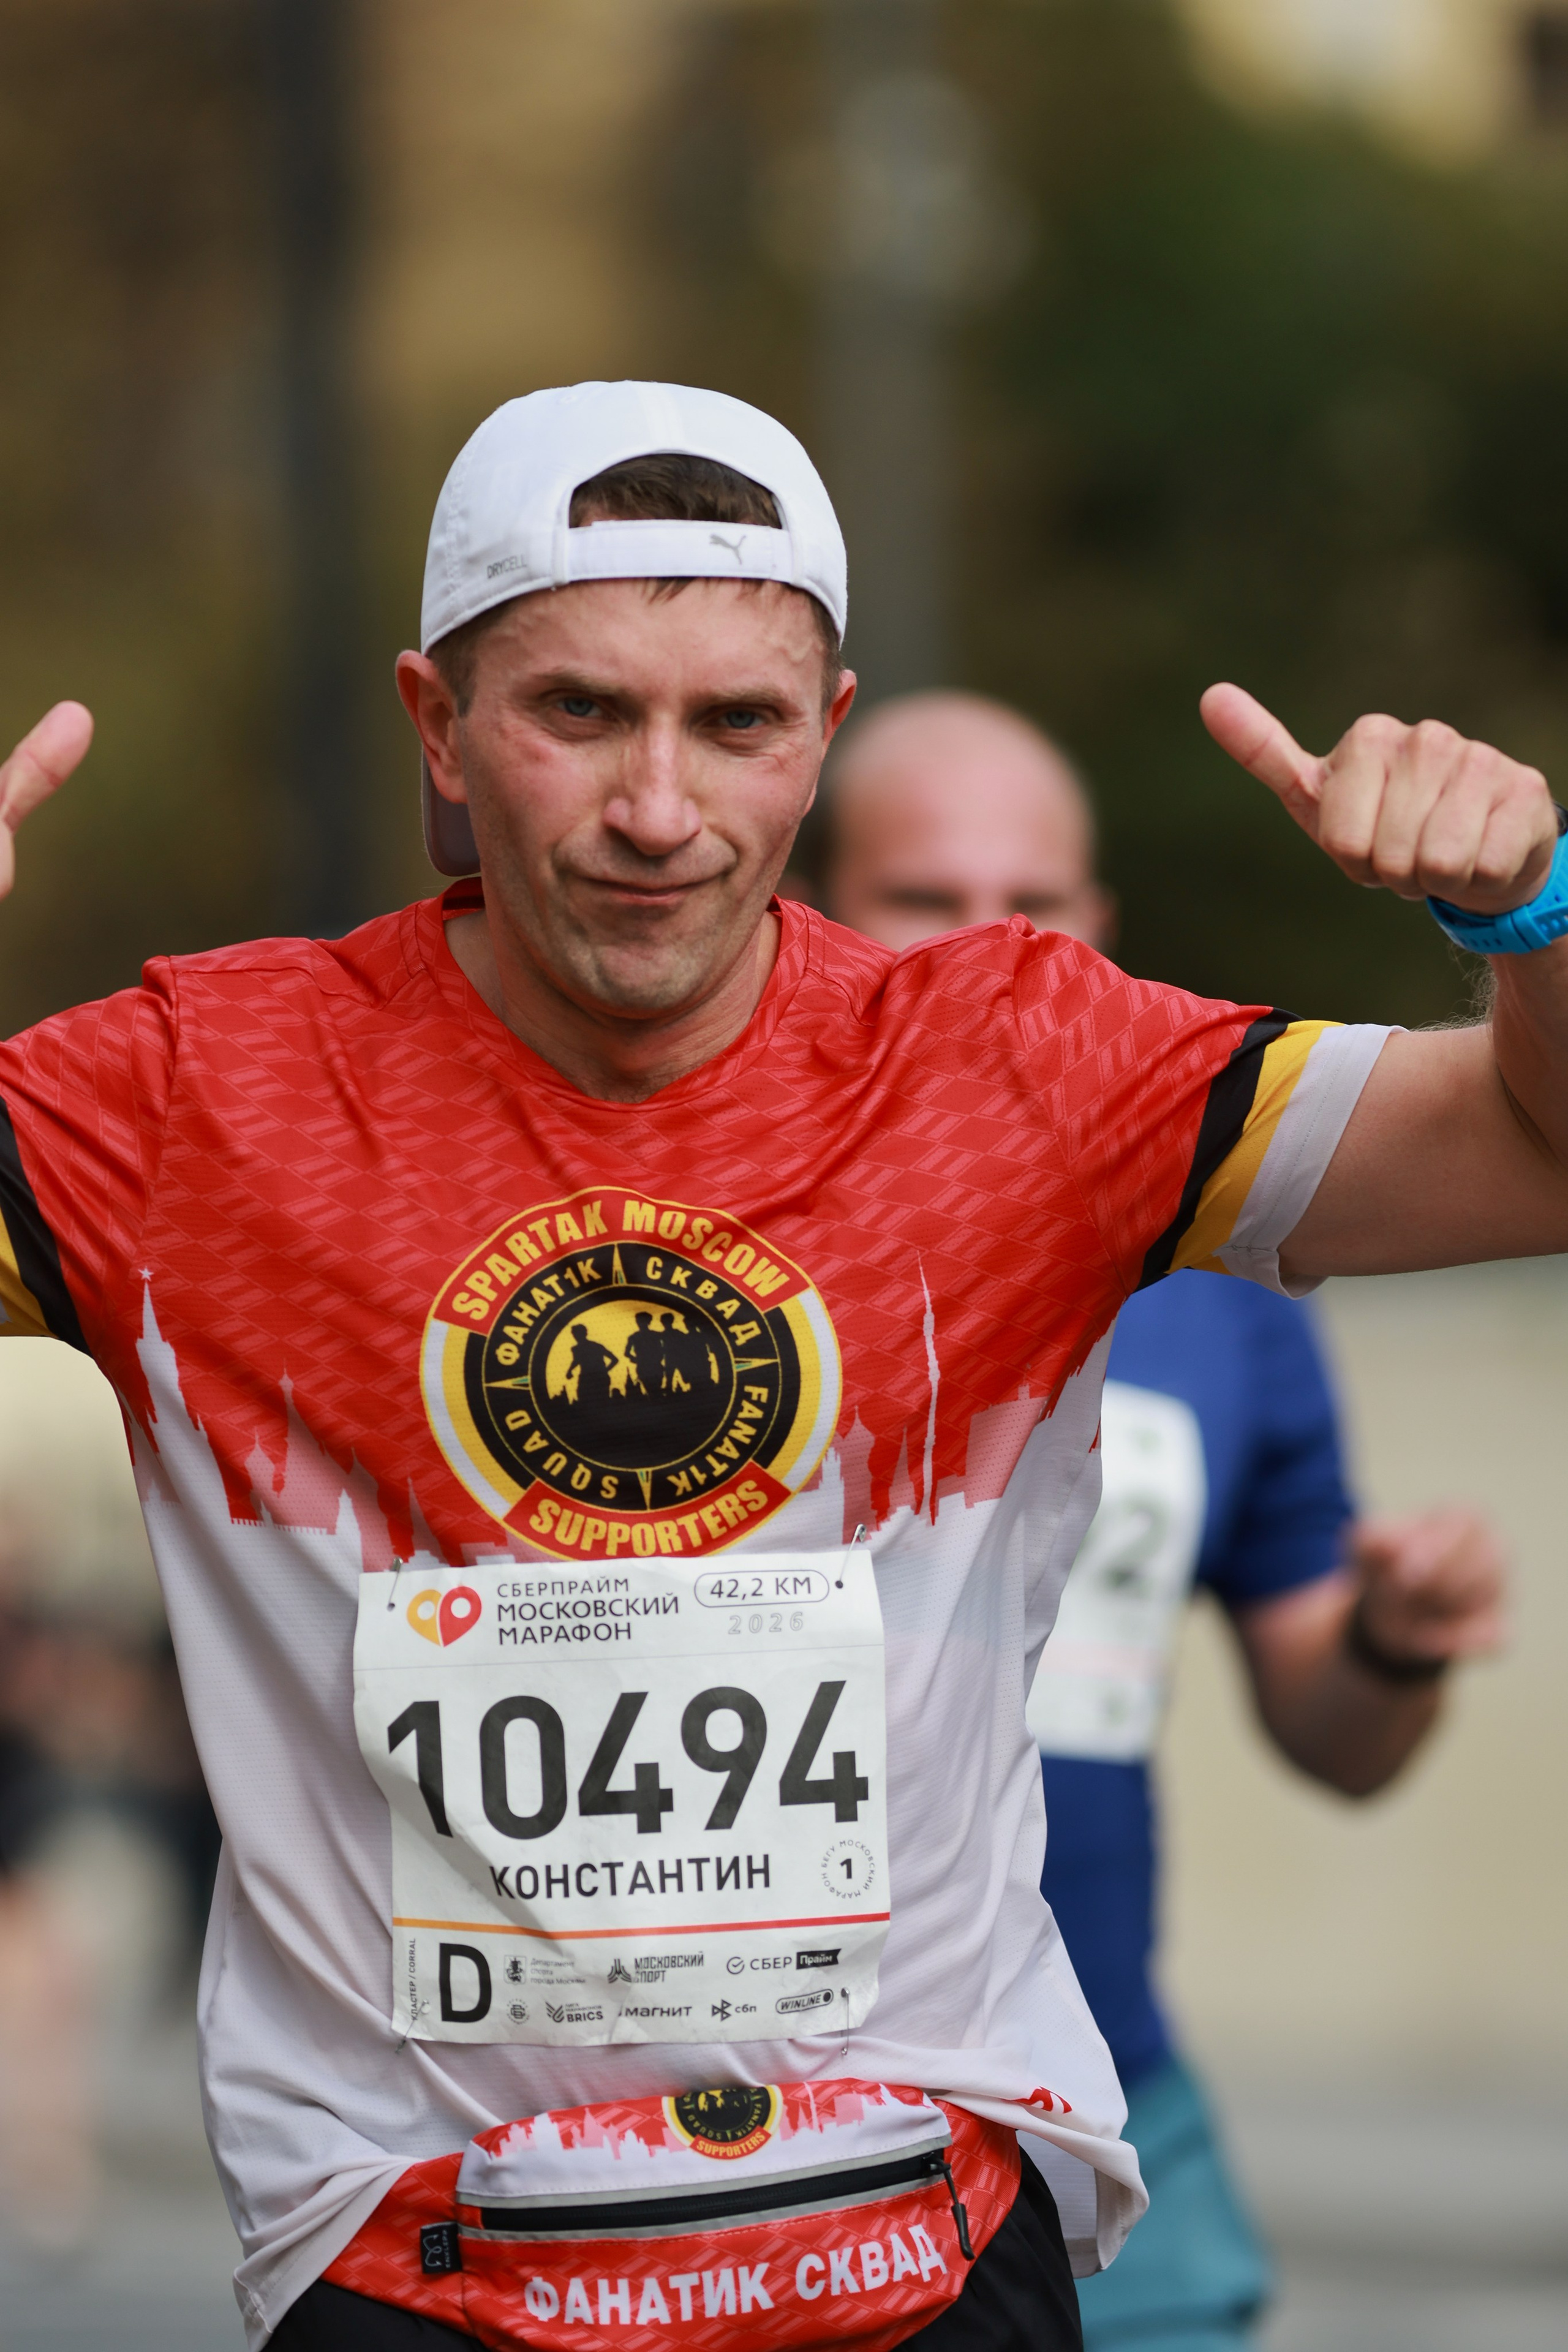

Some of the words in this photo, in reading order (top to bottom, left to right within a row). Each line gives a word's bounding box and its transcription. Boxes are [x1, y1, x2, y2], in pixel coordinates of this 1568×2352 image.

[487, 554, 527, 579] DRYCELL
[452, 1200, 608, 1321] SPARTAK
[622, 1199, 790, 1297] MOSCOW
[646, 1256, 763, 1346] СКВАД
[504, 1410, 619, 1500] SQUAD
[529, 1480, 768, 1556] SUPPORTERS
[497, 1577, 629, 1597] СБЕРПРАЙМ
[710, 1578, 764, 1600] 42,2
[775, 1577, 812, 1595] КМ
[497, 1593, 679, 1622] МОСКОВСКИЙ
[499, 1622, 631, 1645] МАРАФОН
[728, 1611, 804, 1634] 2026
[388, 1680, 870, 1840] 10494
[488, 1854, 771, 1900] КОНСТАНТИН
[840, 1858, 853, 1879] 1
[821, 1873, 861, 1899] МАРАФОН
[635, 1952, 704, 1970] МОСКОВСКИЙ
[750, 1957, 792, 1970] СБЕР
[800, 1954, 832, 1966] Прайм
[439, 1943, 492, 2023] D
[634, 1970, 666, 1983] СПОРТ
[625, 2006, 693, 2018] магнит
[735, 2003, 756, 2013] сбп
[780, 1994, 821, 2011] WINLINE
[567, 2011, 603, 2022] BRICS
[696, 2132, 765, 2157] SUPPORTERS
[525, 2263, 774, 2326] ФАНАТИК
[795, 2224, 948, 2301] СКВАД
